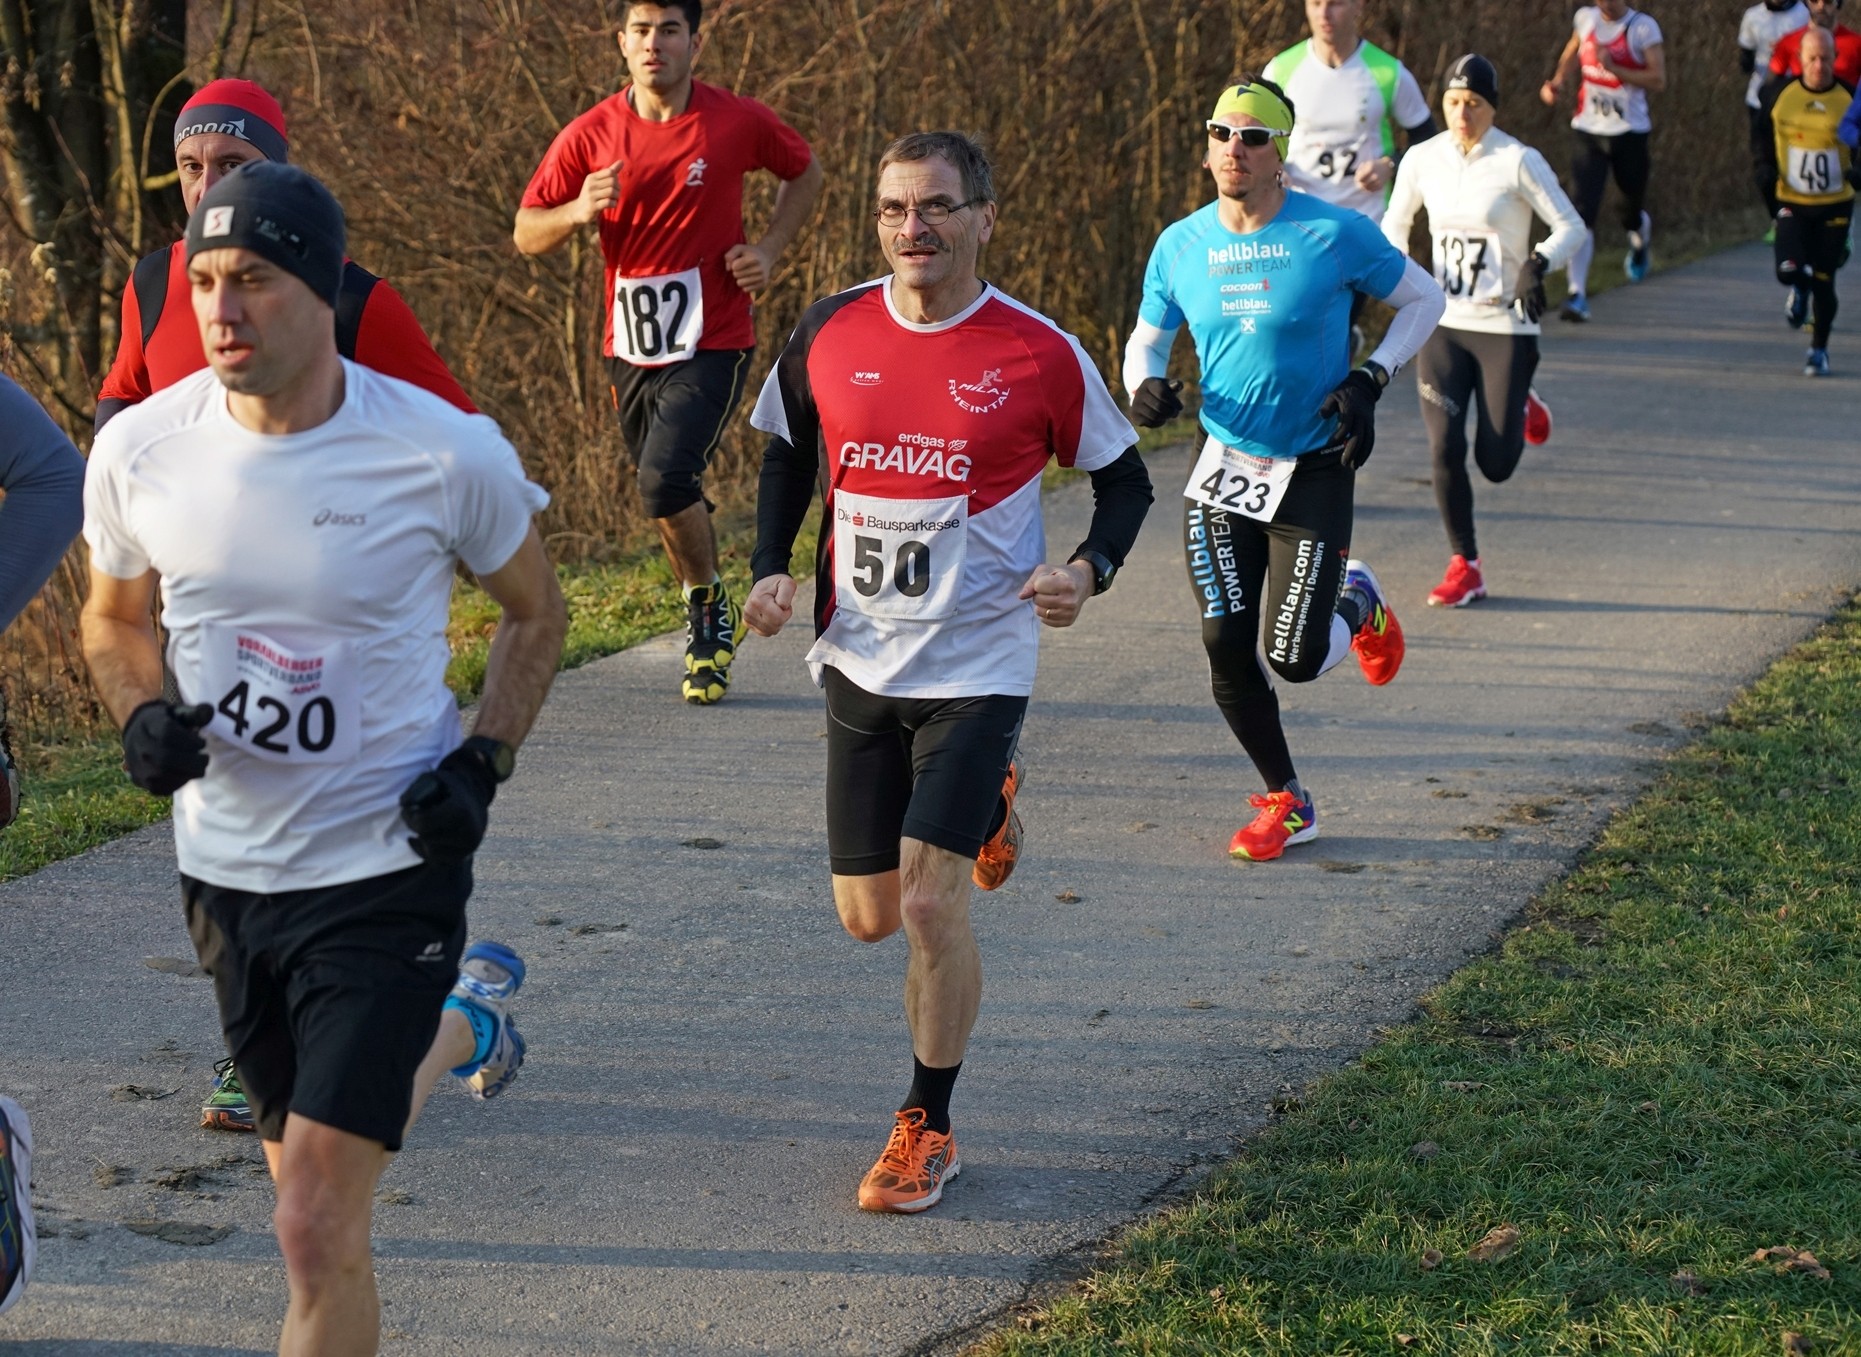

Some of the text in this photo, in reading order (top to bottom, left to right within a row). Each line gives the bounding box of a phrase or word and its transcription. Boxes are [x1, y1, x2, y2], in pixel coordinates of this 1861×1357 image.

[1319, 148, 1358, 178] 92
[1799, 152, 1830, 192] 49
[1208, 241, 1291, 265] hellblau.
[1208, 258, 1292, 278] POWERTEAM
[1440, 235, 1487, 296] 137
[1220, 282, 1263, 293] cocoon
[1221, 299, 1272, 311] hellblau.
[617, 280, 689, 357] 182
[948, 379, 1011, 414] RHEINTAL
[898, 433, 945, 448] erdgas
[839, 441, 973, 482] GRAVAG
[1200, 468, 1271, 514] 423
[837, 508, 851, 523] Die
[867, 515, 960, 533] Bausparkasse
[852, 534, 931, 598] 50
[1187, 501, 1225, 619] hellblau.
[1269, 539, 1313, 663] hellblau.com
[1288, 592, 1313, 664] Werbeagentur
[1307, 541, 1325, 586] Dornbirn
[218, 680, 336, 754] 420
